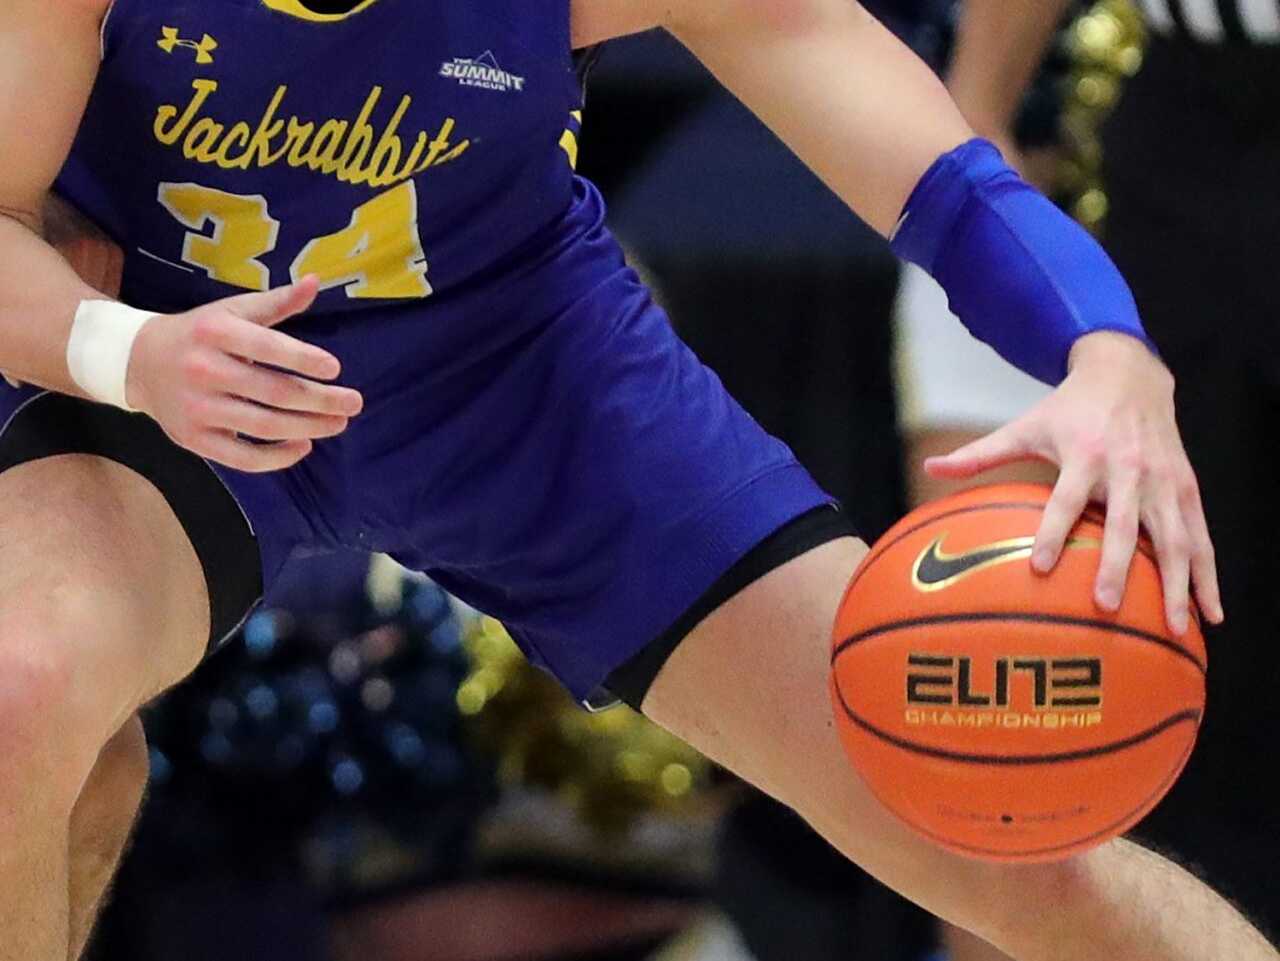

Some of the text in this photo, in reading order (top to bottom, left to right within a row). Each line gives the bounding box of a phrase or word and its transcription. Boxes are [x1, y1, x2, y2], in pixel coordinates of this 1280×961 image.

[439, 62, 525, 91] SUMMIT
[459, 78, 507, 91] LEAGUE
[157, 178, 433, 298] 34
[906, 654, 1102, 707] ELITE
[904, 708, 1102, 728] CHAMPIONSHIP
